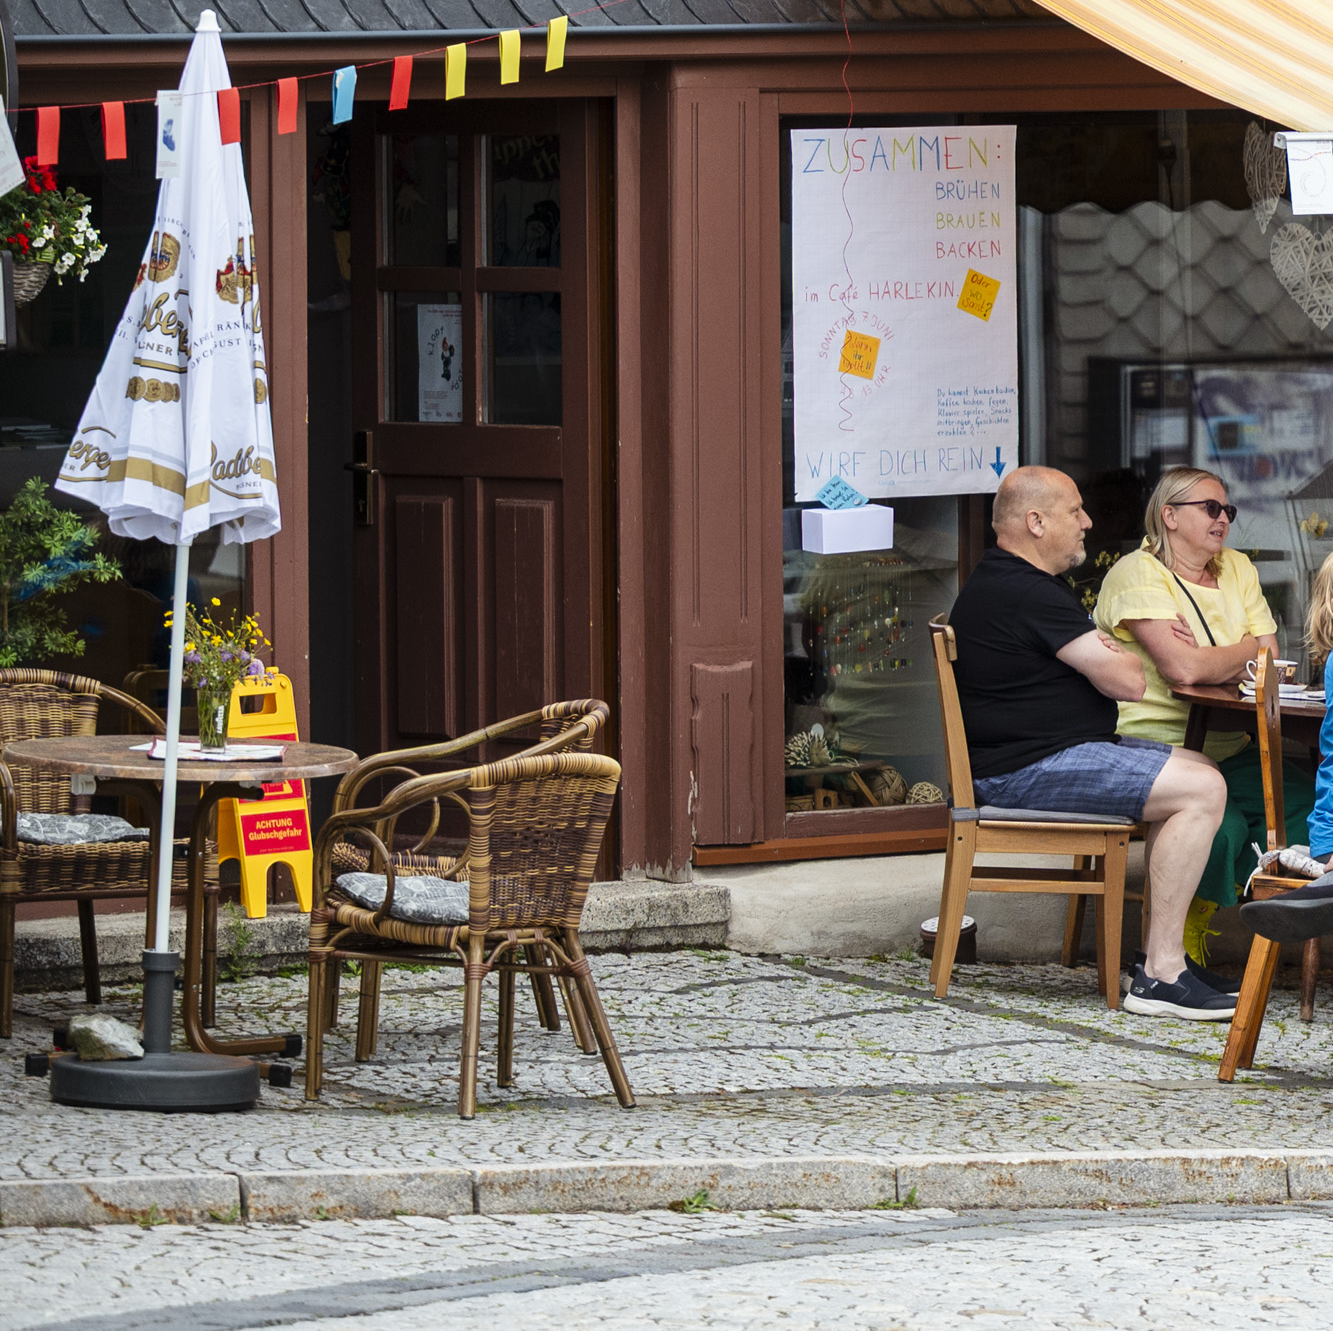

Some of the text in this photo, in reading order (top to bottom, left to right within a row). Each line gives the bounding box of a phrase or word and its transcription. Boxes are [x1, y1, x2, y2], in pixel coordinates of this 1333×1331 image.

[935, 179, 1000, 200] BRÜHEN
[936, 210, 1000, 229] BRAUEN
[936, 239, 1001, 259] BACKEN
[971, 273, 991, 288] Oder
[805, 286, 819, 302] im
[829, 283, 859, 304] Café
[871, 314, 895, 340] JUNI
[874, 365, 892, 388] UHR
[937, 388, 946, 397] Du
[806, 446, 984, 479] WIRF DICH REIN
[248, 827, 302, 841] Glubschgefahr
[256, 818, 293, 830] ACHTUNG
